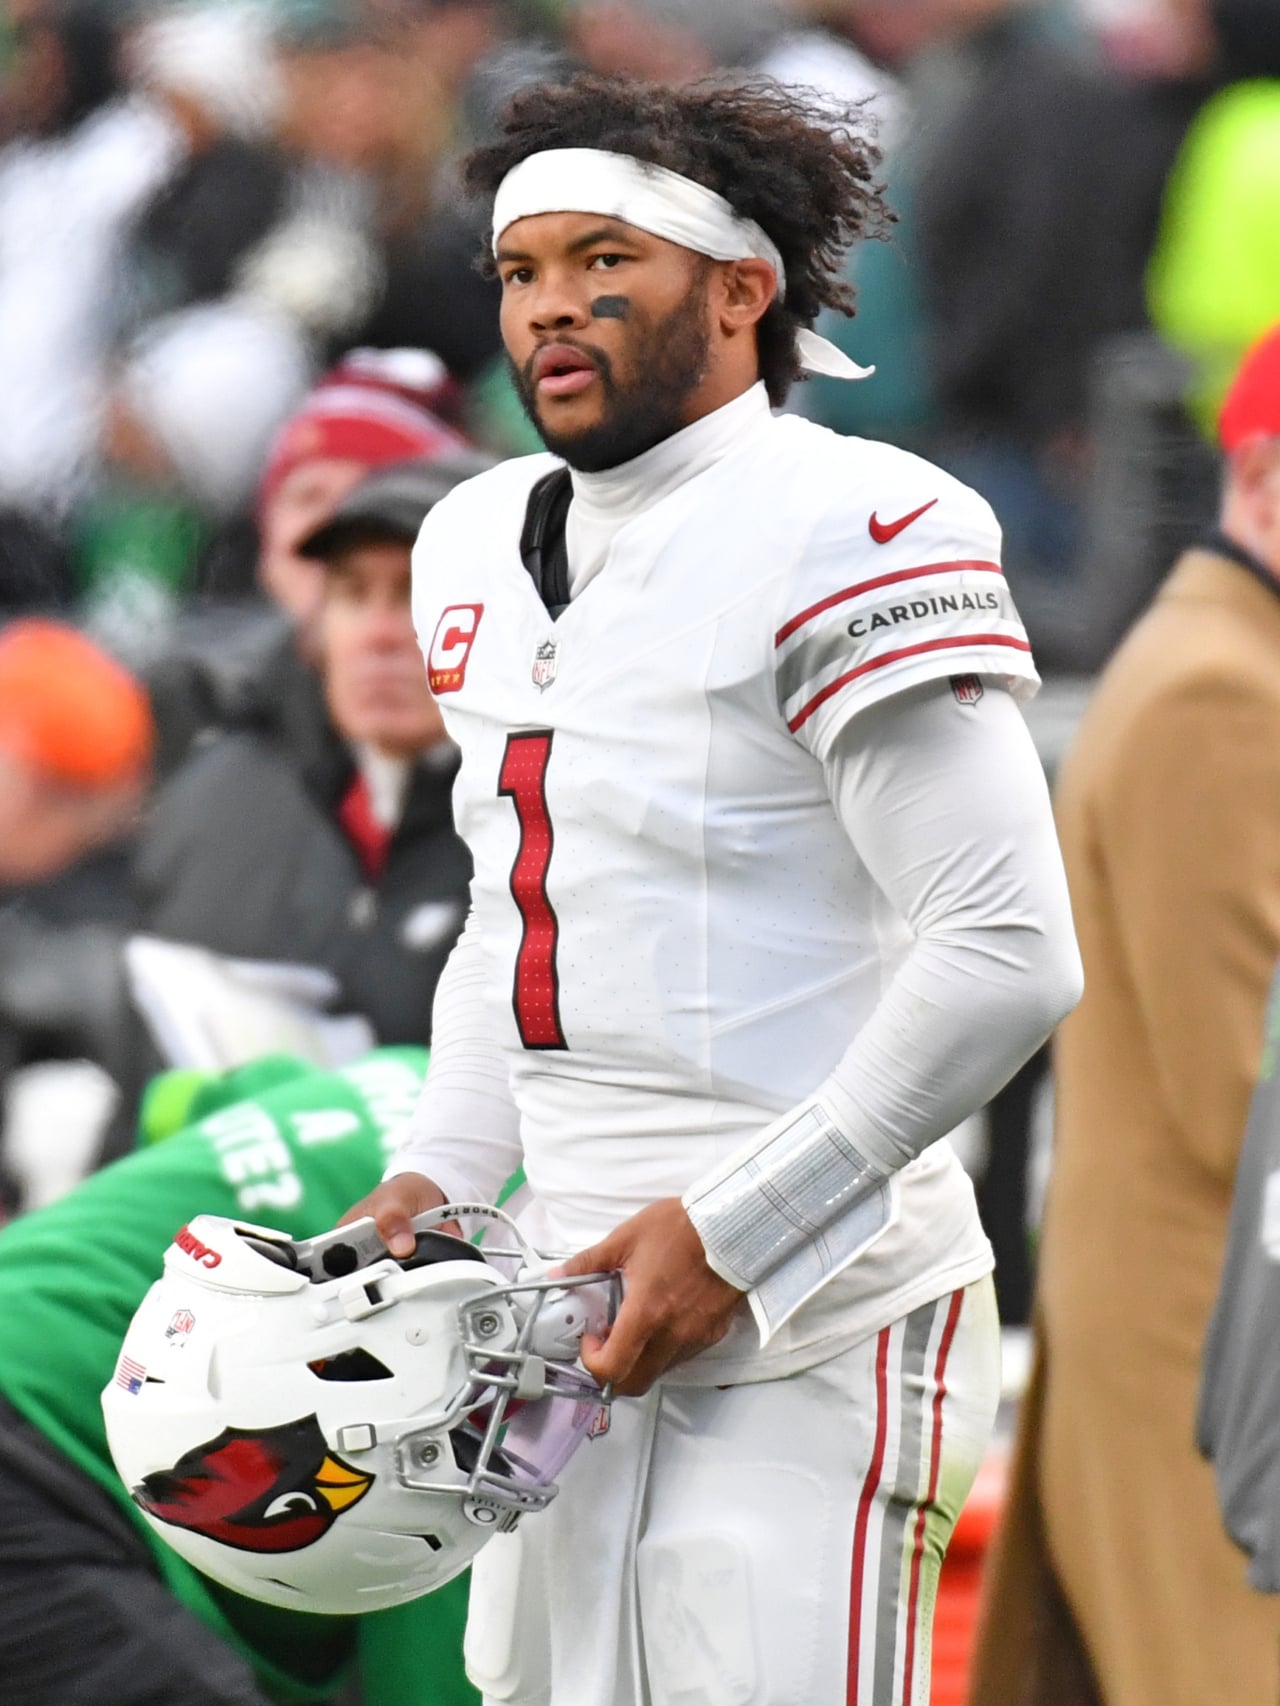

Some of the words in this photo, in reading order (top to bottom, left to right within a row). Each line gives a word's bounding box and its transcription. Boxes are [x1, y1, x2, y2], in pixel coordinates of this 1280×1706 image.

[429, 607, 476, 670] C
[847, 592, 999, 638] CARDINALS
[497, 728, 569, 1051] 1
